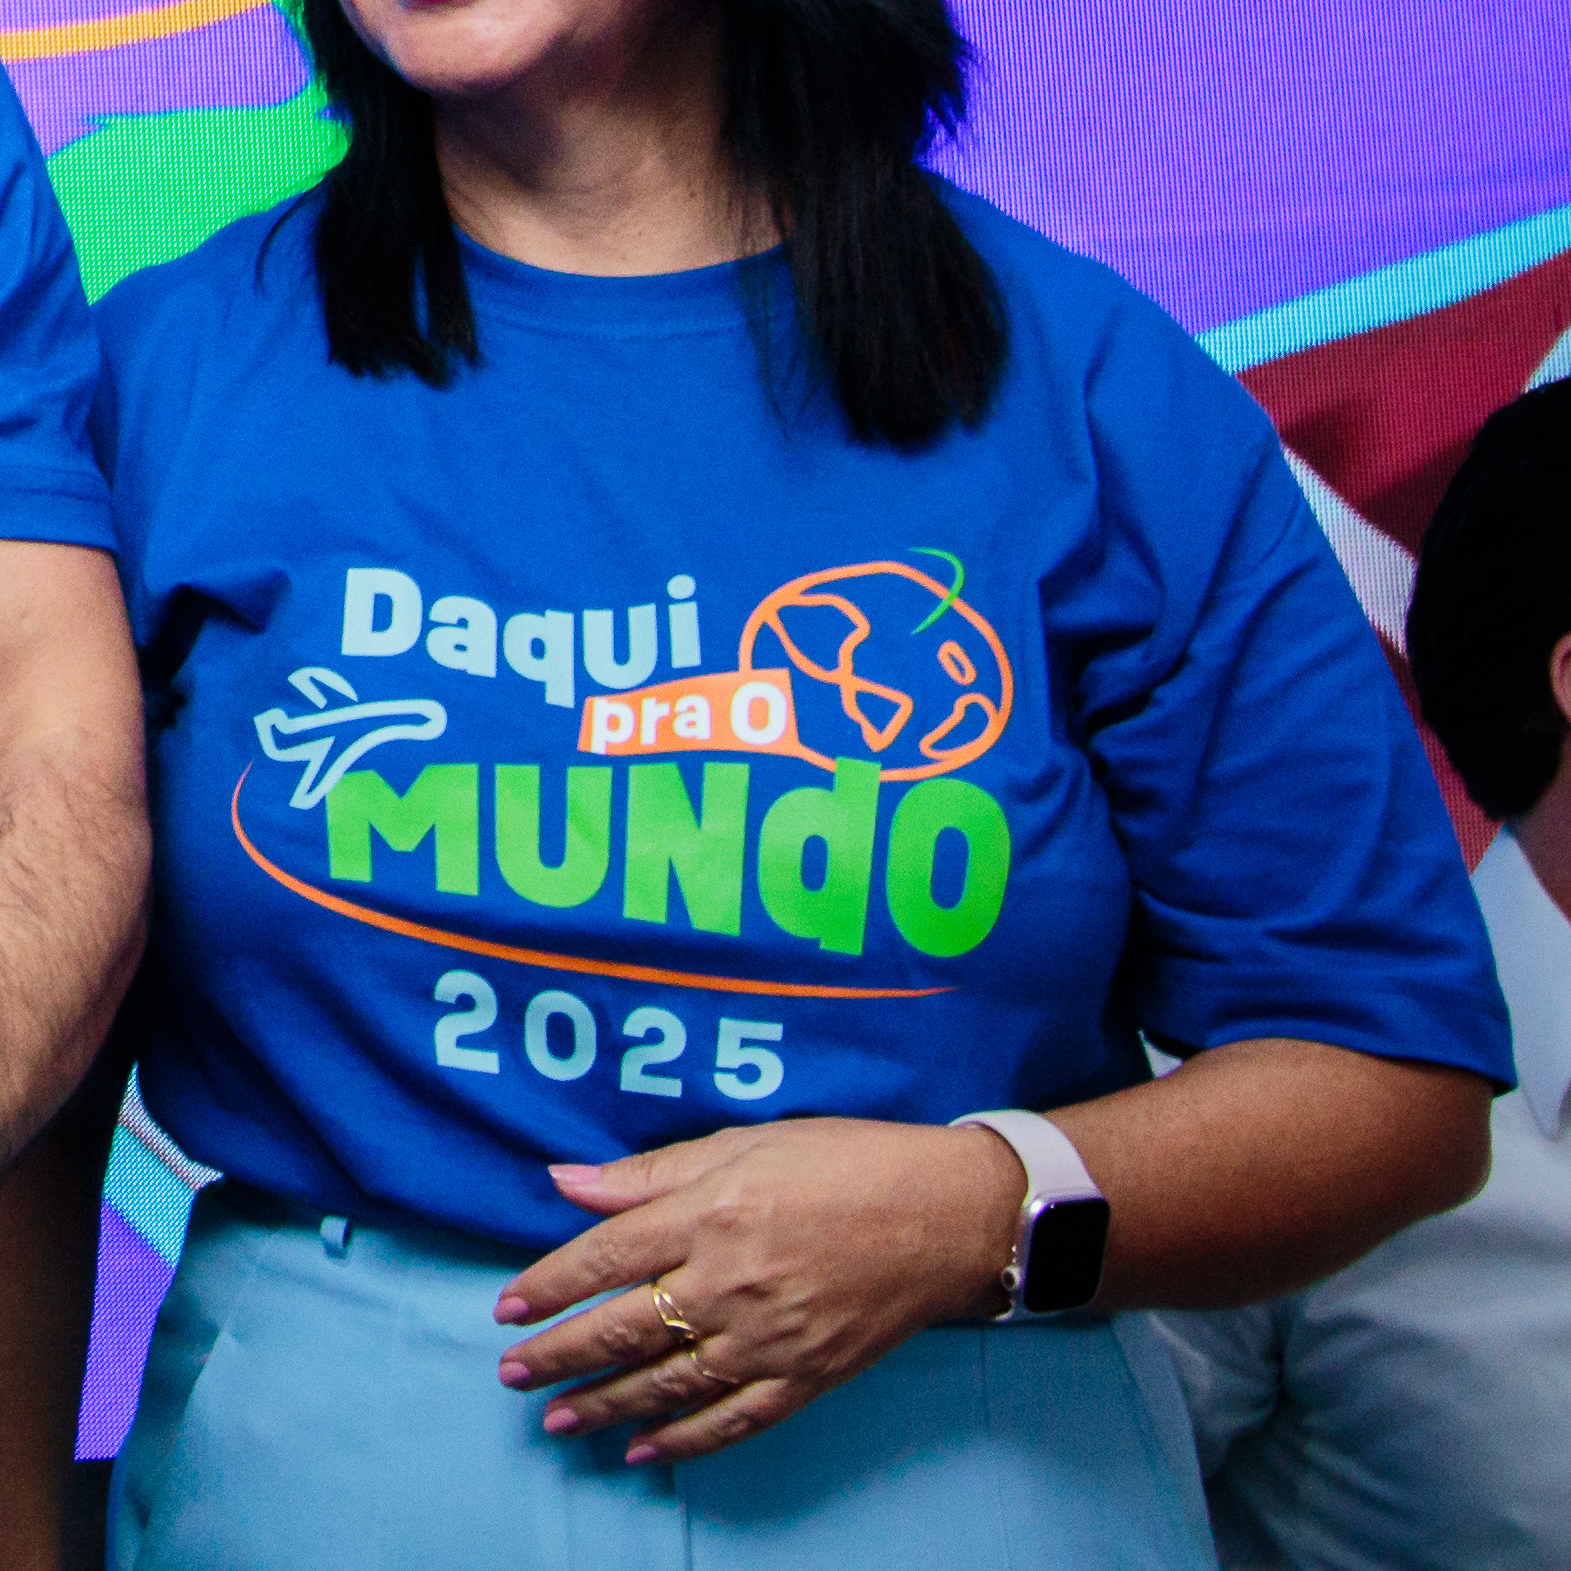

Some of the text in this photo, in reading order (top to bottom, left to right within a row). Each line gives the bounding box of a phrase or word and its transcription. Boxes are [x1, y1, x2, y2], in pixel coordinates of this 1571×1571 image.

[340, 567, 702, 709] Daqui
[589, 693, 713, 756] pra
[432, 969, 786, 1100] 2025
